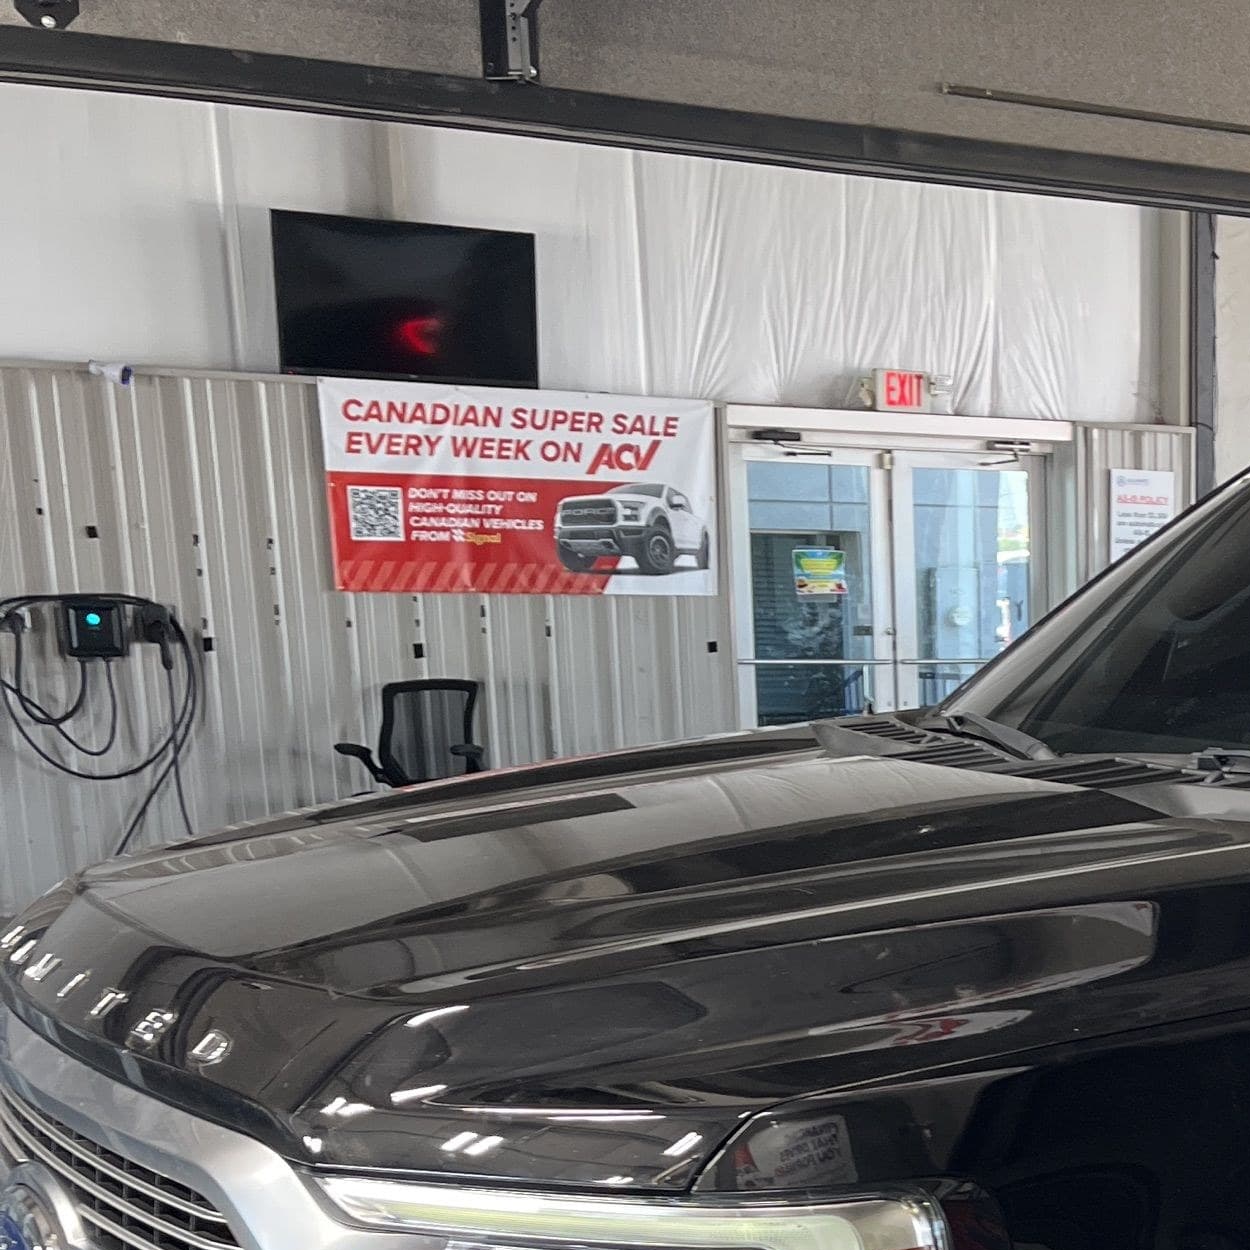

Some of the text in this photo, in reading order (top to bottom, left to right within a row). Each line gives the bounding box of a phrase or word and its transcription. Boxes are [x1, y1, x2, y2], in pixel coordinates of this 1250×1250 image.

[885, 371, 924, 407] EXIT
[341, 398, 680, 437] CANADIAN SUPER SALE
[345, 431, 662, 475] EVERY WEEK ON ACV
[408, 487, 538, 503] DON'T MISS OUT ON
[408, 502, 503, 515] HIGH-QUALITY
[408, 516, 545, 530] CANADIAN VEHICLES
[410, 530, 451, 542] FROM
